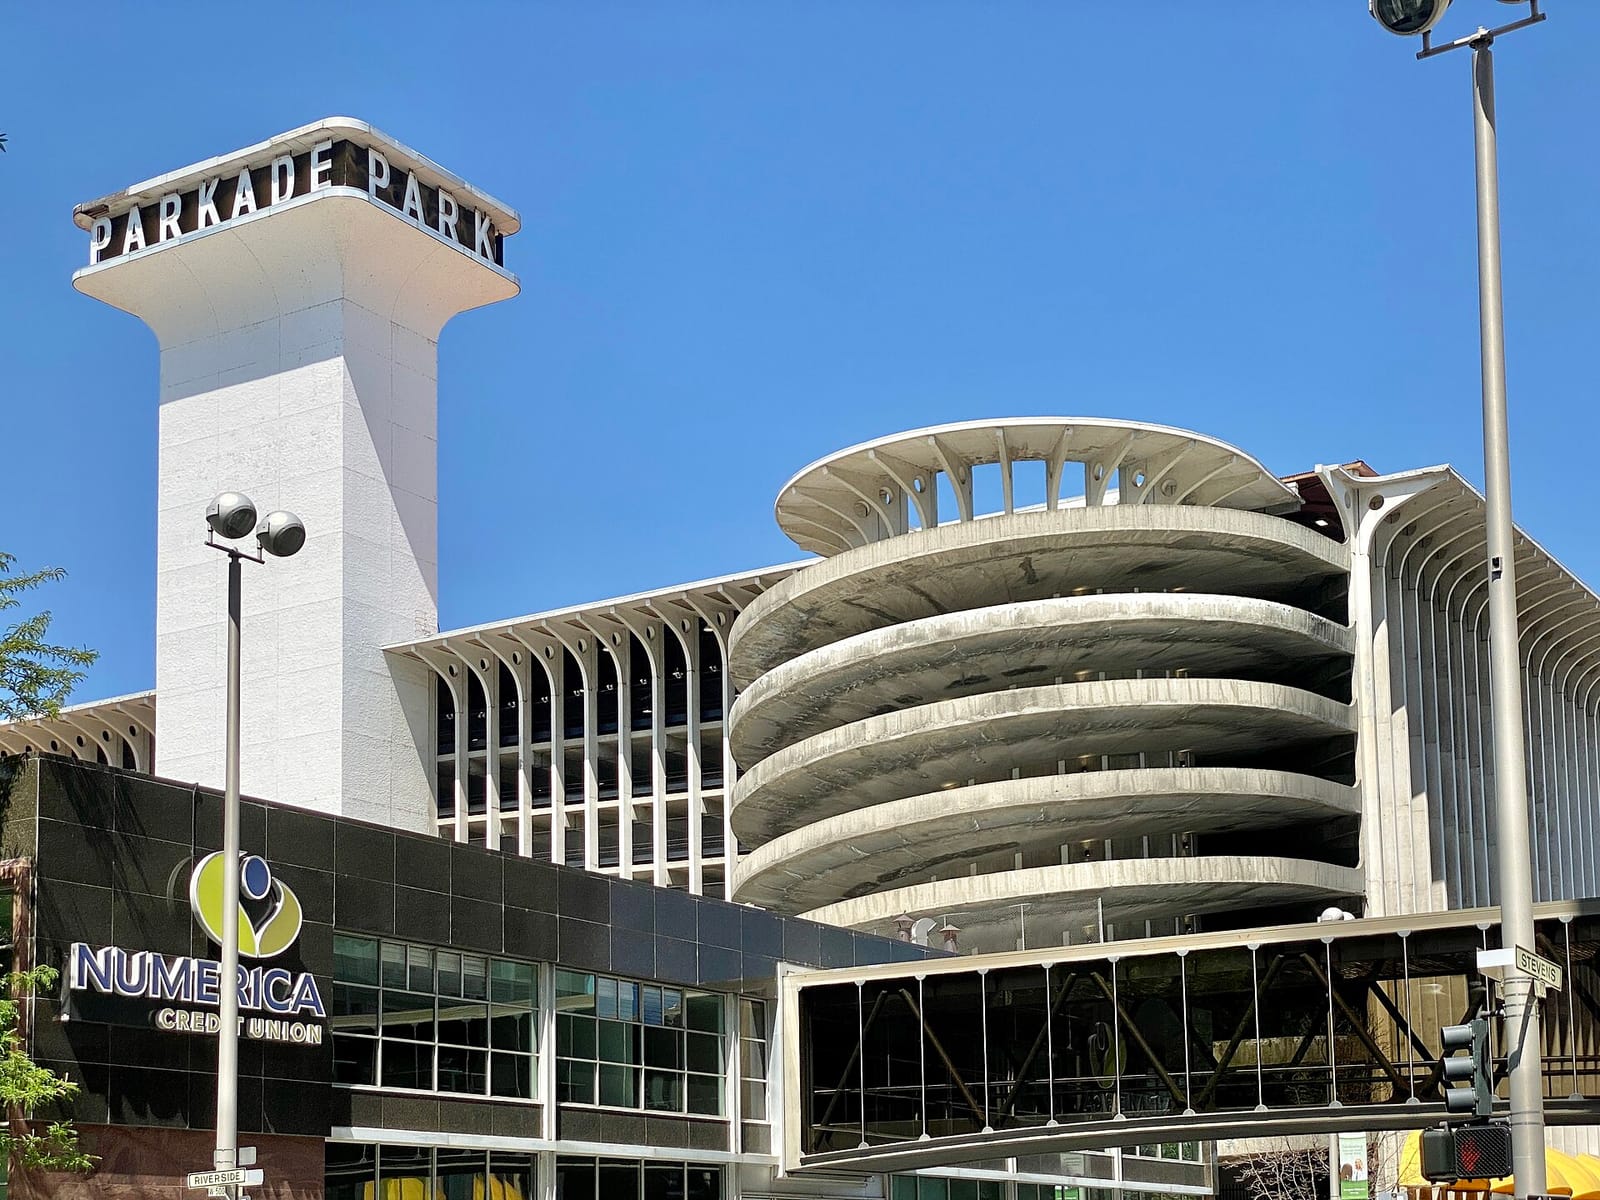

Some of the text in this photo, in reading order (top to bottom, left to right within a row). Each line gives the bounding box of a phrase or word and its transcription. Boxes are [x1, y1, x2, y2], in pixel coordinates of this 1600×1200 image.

[89, 138, 496, 265] PARKADE PARK
[70, 942, 327, 1018] NUMERICA
[1521, 953, 1556, 982] STEVENS
[156, 1007, 323, 1045] CREDT UNION
[194, 1171, 241, 1185] RIVERSIDE
